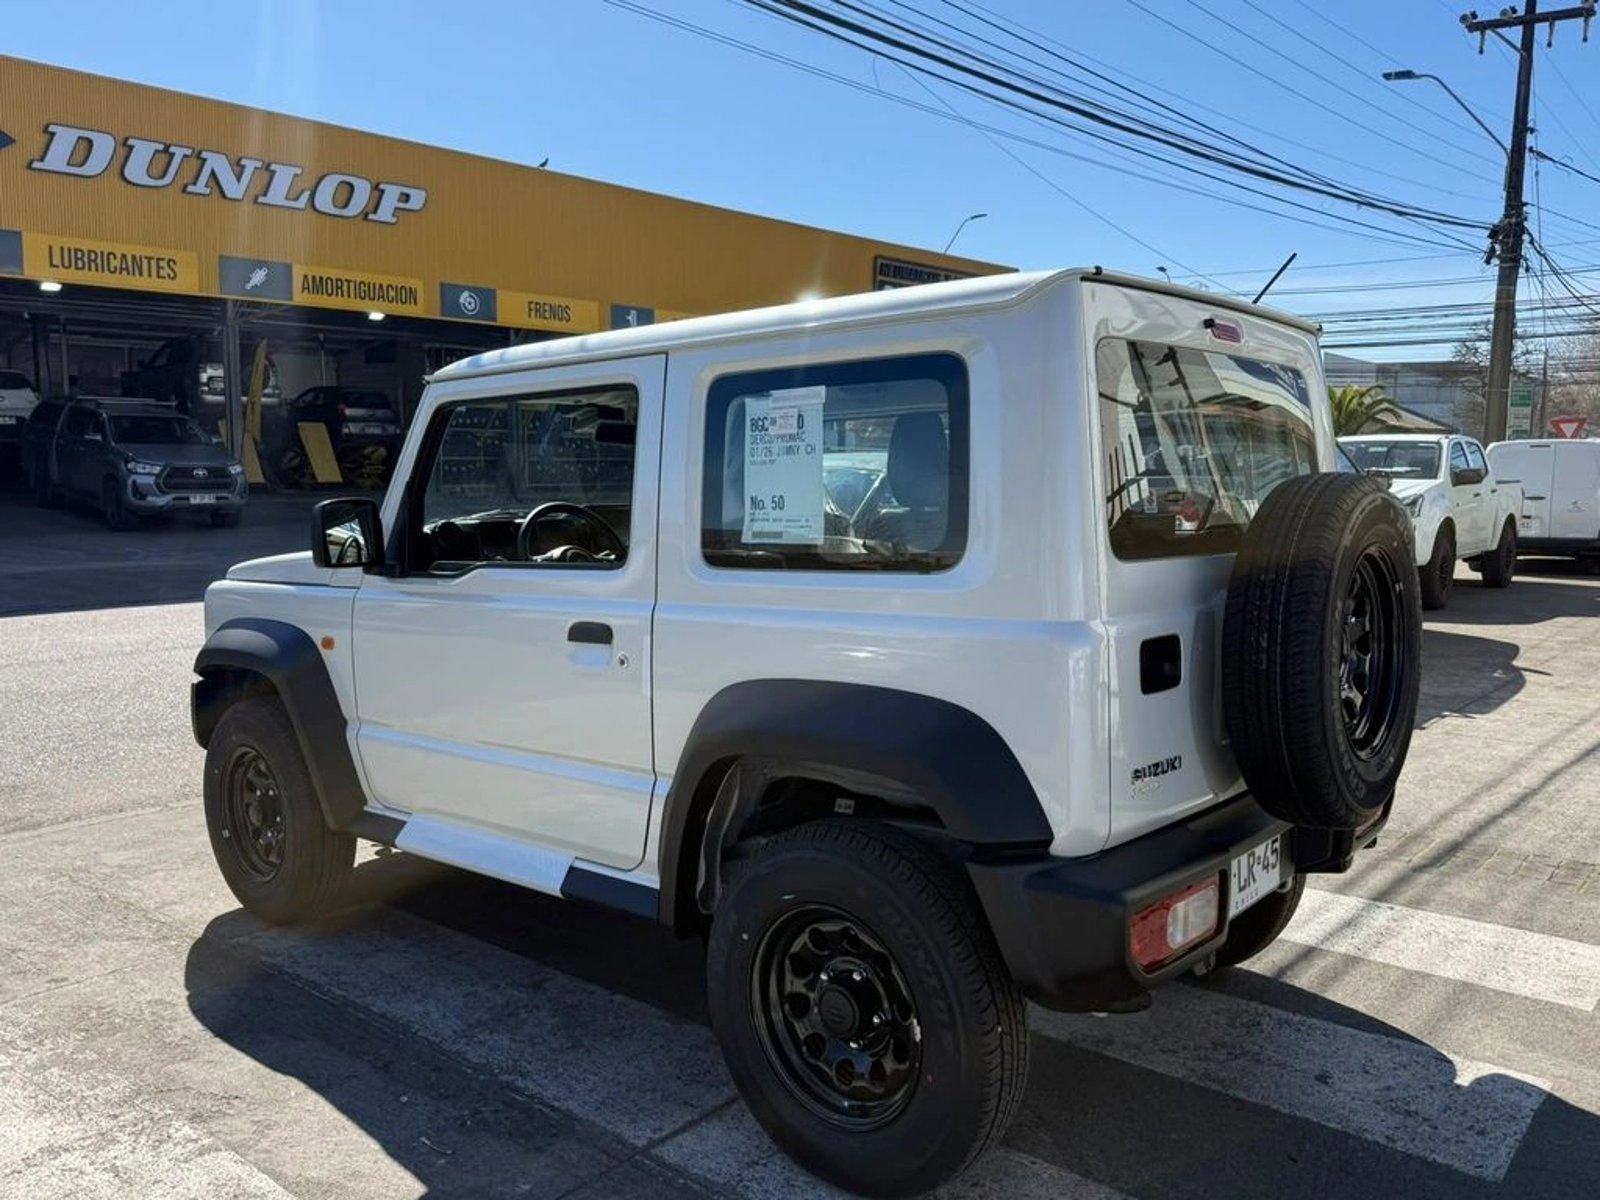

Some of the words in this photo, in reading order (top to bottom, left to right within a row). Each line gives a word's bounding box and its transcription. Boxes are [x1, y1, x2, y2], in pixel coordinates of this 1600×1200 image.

[30, 123, 427, 225] DUNLOP
[48, 244, 178, 281] LUBRICANTES
[301, 274, 418, 306] AMORTIGUACION
[527, 300, 571, 323] FRENOS
[771, 494, 785, 511] 50
[1131, 755, 1182, 781] SUZUKI
